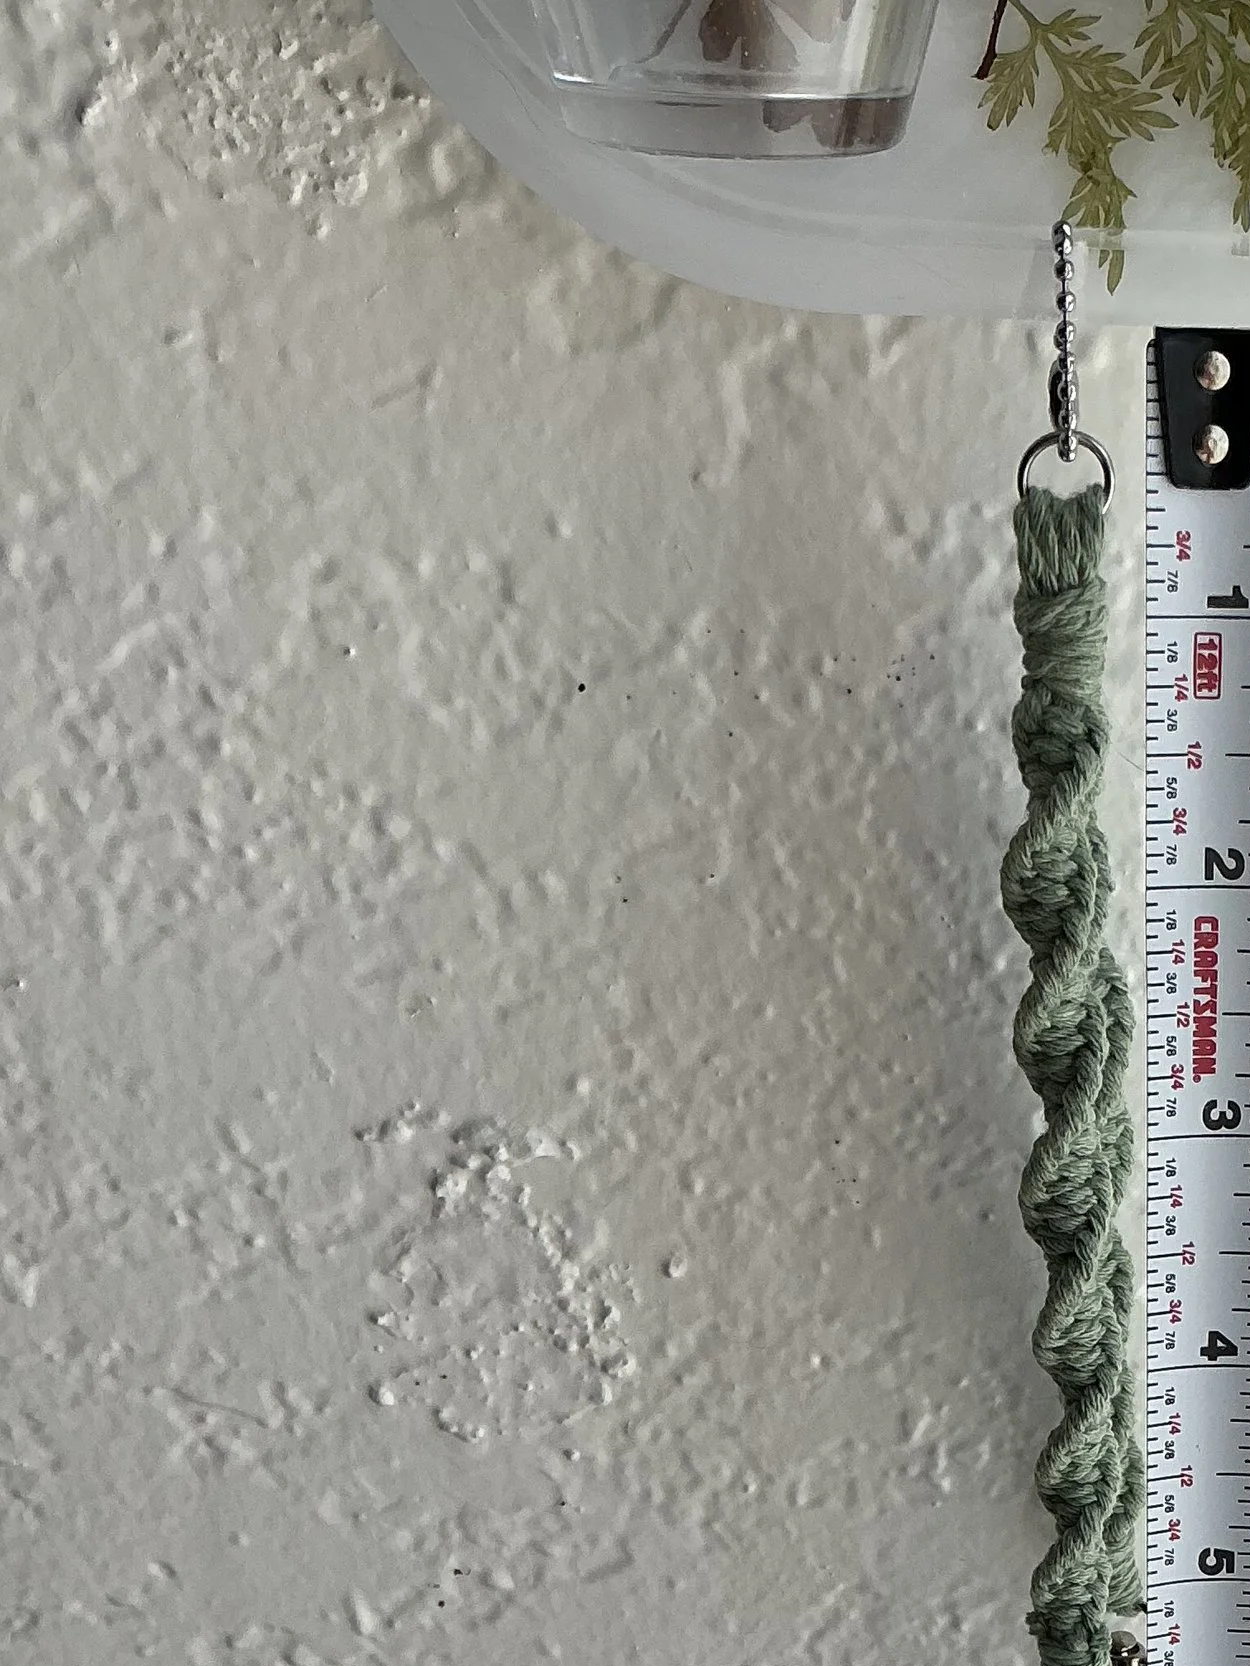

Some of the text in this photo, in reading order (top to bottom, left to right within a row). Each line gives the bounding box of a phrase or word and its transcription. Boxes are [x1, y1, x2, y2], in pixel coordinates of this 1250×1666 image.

[1176, 530, 1191, 561] 3/4
[1167, 570, 1178, 593] 7/8
[1207, 585, 1249, 608] 1
[1166, 641, 1177, 663] 1/8
[1197, 638, 1218, 693] 12ft
[1174, 674, 1188, 702] 1/4
[1166, 709, 1177, 732] 3/8
[1188, 741, 1202, 770] 1/2
[1166, 777, 1177, 799] 5/8
[1173, 807, 1187, 835] 3/4
[1166, 844, 1177, 865] 7/8
[1204, 847, 1245, 881] 2
[1166, 910, 1177, 930] 1/8
[1172, 939, 1185, 965] 1/4
[1166, 972, 1177, 994] 3/8
[1177, 1002, 1189, 1028] 1/2
[1166, 1036, 1176, 1056] 5/8
[1171, 1064, 1184, 1090] 3/4
[1166, 1097, 1176, 1117] 7/8
[1202, 1099, 1241, 1130] 3
[1165, 1158, 1176, 1177] 1/8
[1170, 1185, 1182, 1208] 1/4
[1165, 1216, 1176, 1236] 3/8
[1182, 1241, 1195, 1265] 1/2
[1165, 1273, 1175, 1293] 5/8
[1169, 1299, 1182, 1324] 3/4
[1165, 1331, 1175, 1350] 7/8
[1200, 1331, 1238, 1361] 4
[1165, 1387, 1175, 1405] 1/8
[1169, 1413, 1181, 1435] 1/4
[1165, 1441, 1175, 1459] 3/8
[1180, 1465, 1193, 1487] 1/2
[1165, 1495, 1174, 1513] 5/8
[1169, 1519, 1180, 1541] 3/4
[1165, 1548, 1174, 1566] 7/8
[1198, 1547, 1235, 1575] 5
[1164, 1600, 1174, 1618] 1/8
[1168, 1624, 1180, 1645] 1/4
